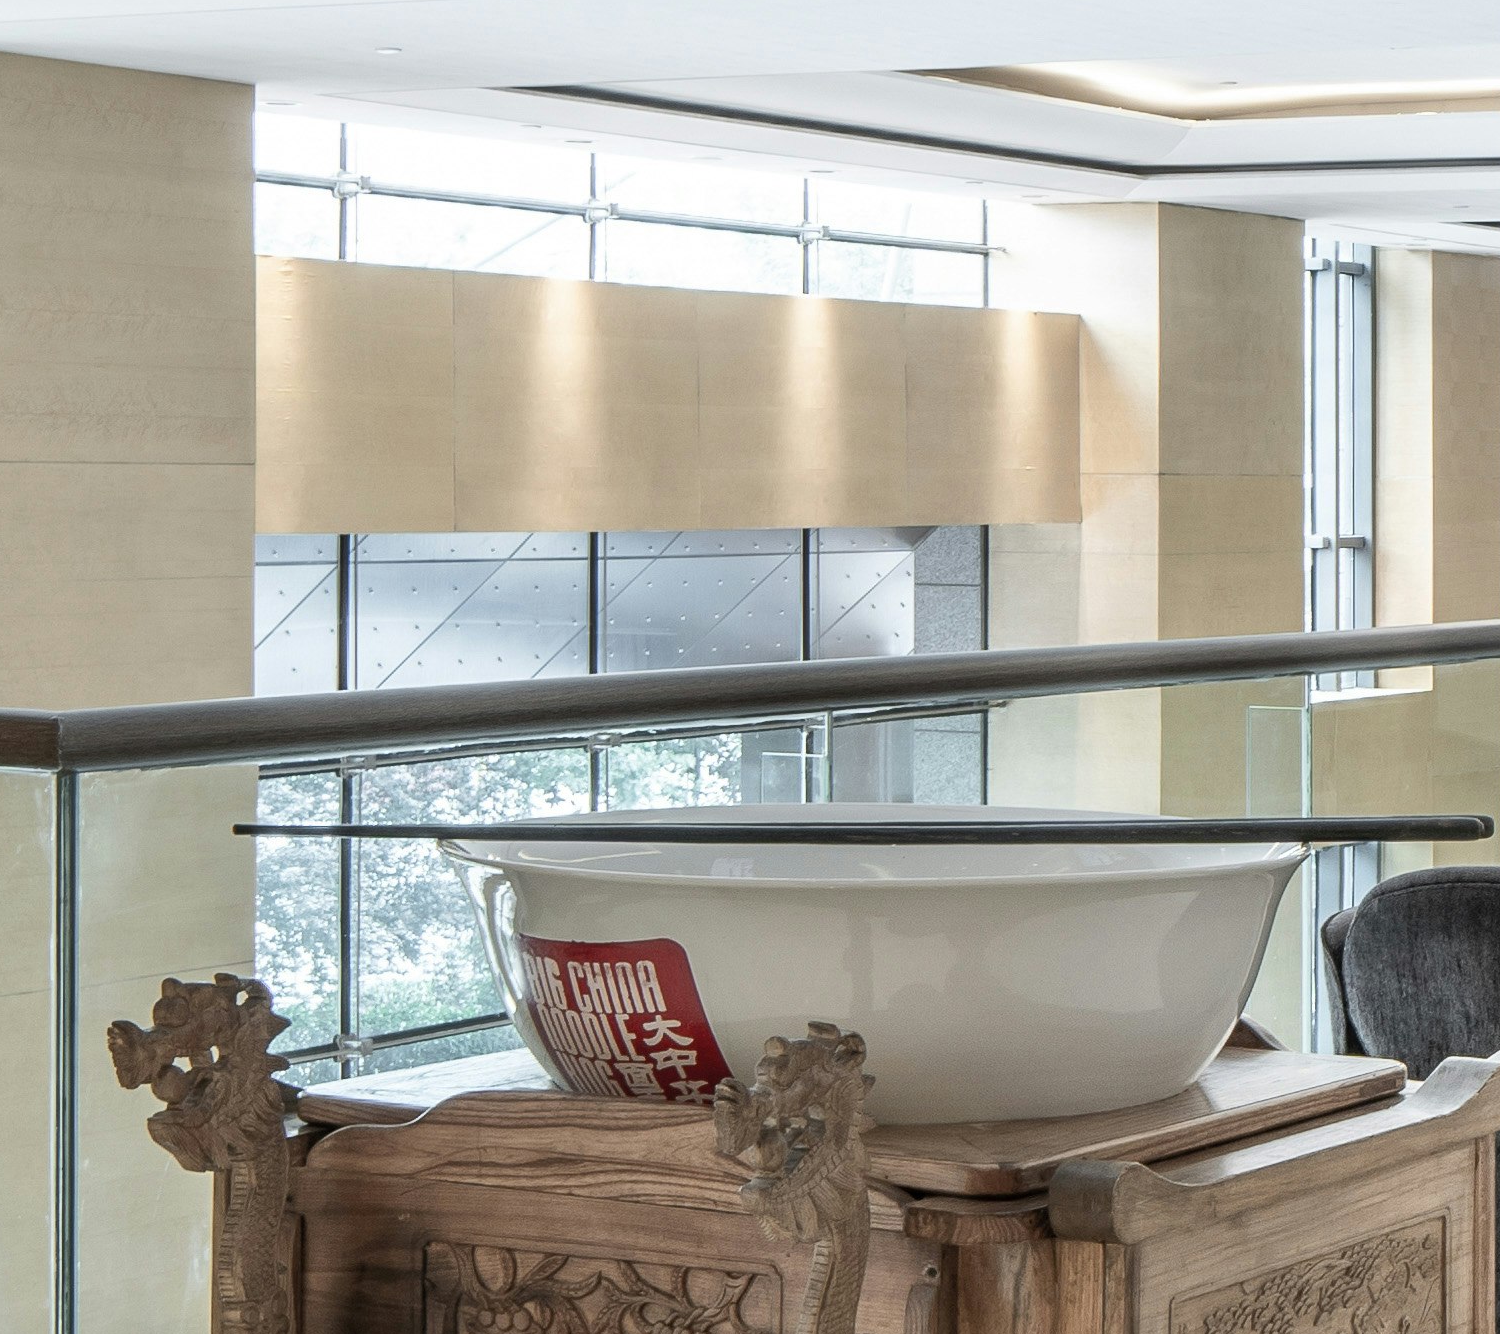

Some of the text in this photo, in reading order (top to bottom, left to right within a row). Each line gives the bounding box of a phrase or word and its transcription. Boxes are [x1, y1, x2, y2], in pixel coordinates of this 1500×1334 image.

[522, 951, 668, 1015] BIG CHINA
[536, 1003, 646, 1062] NOODLE
